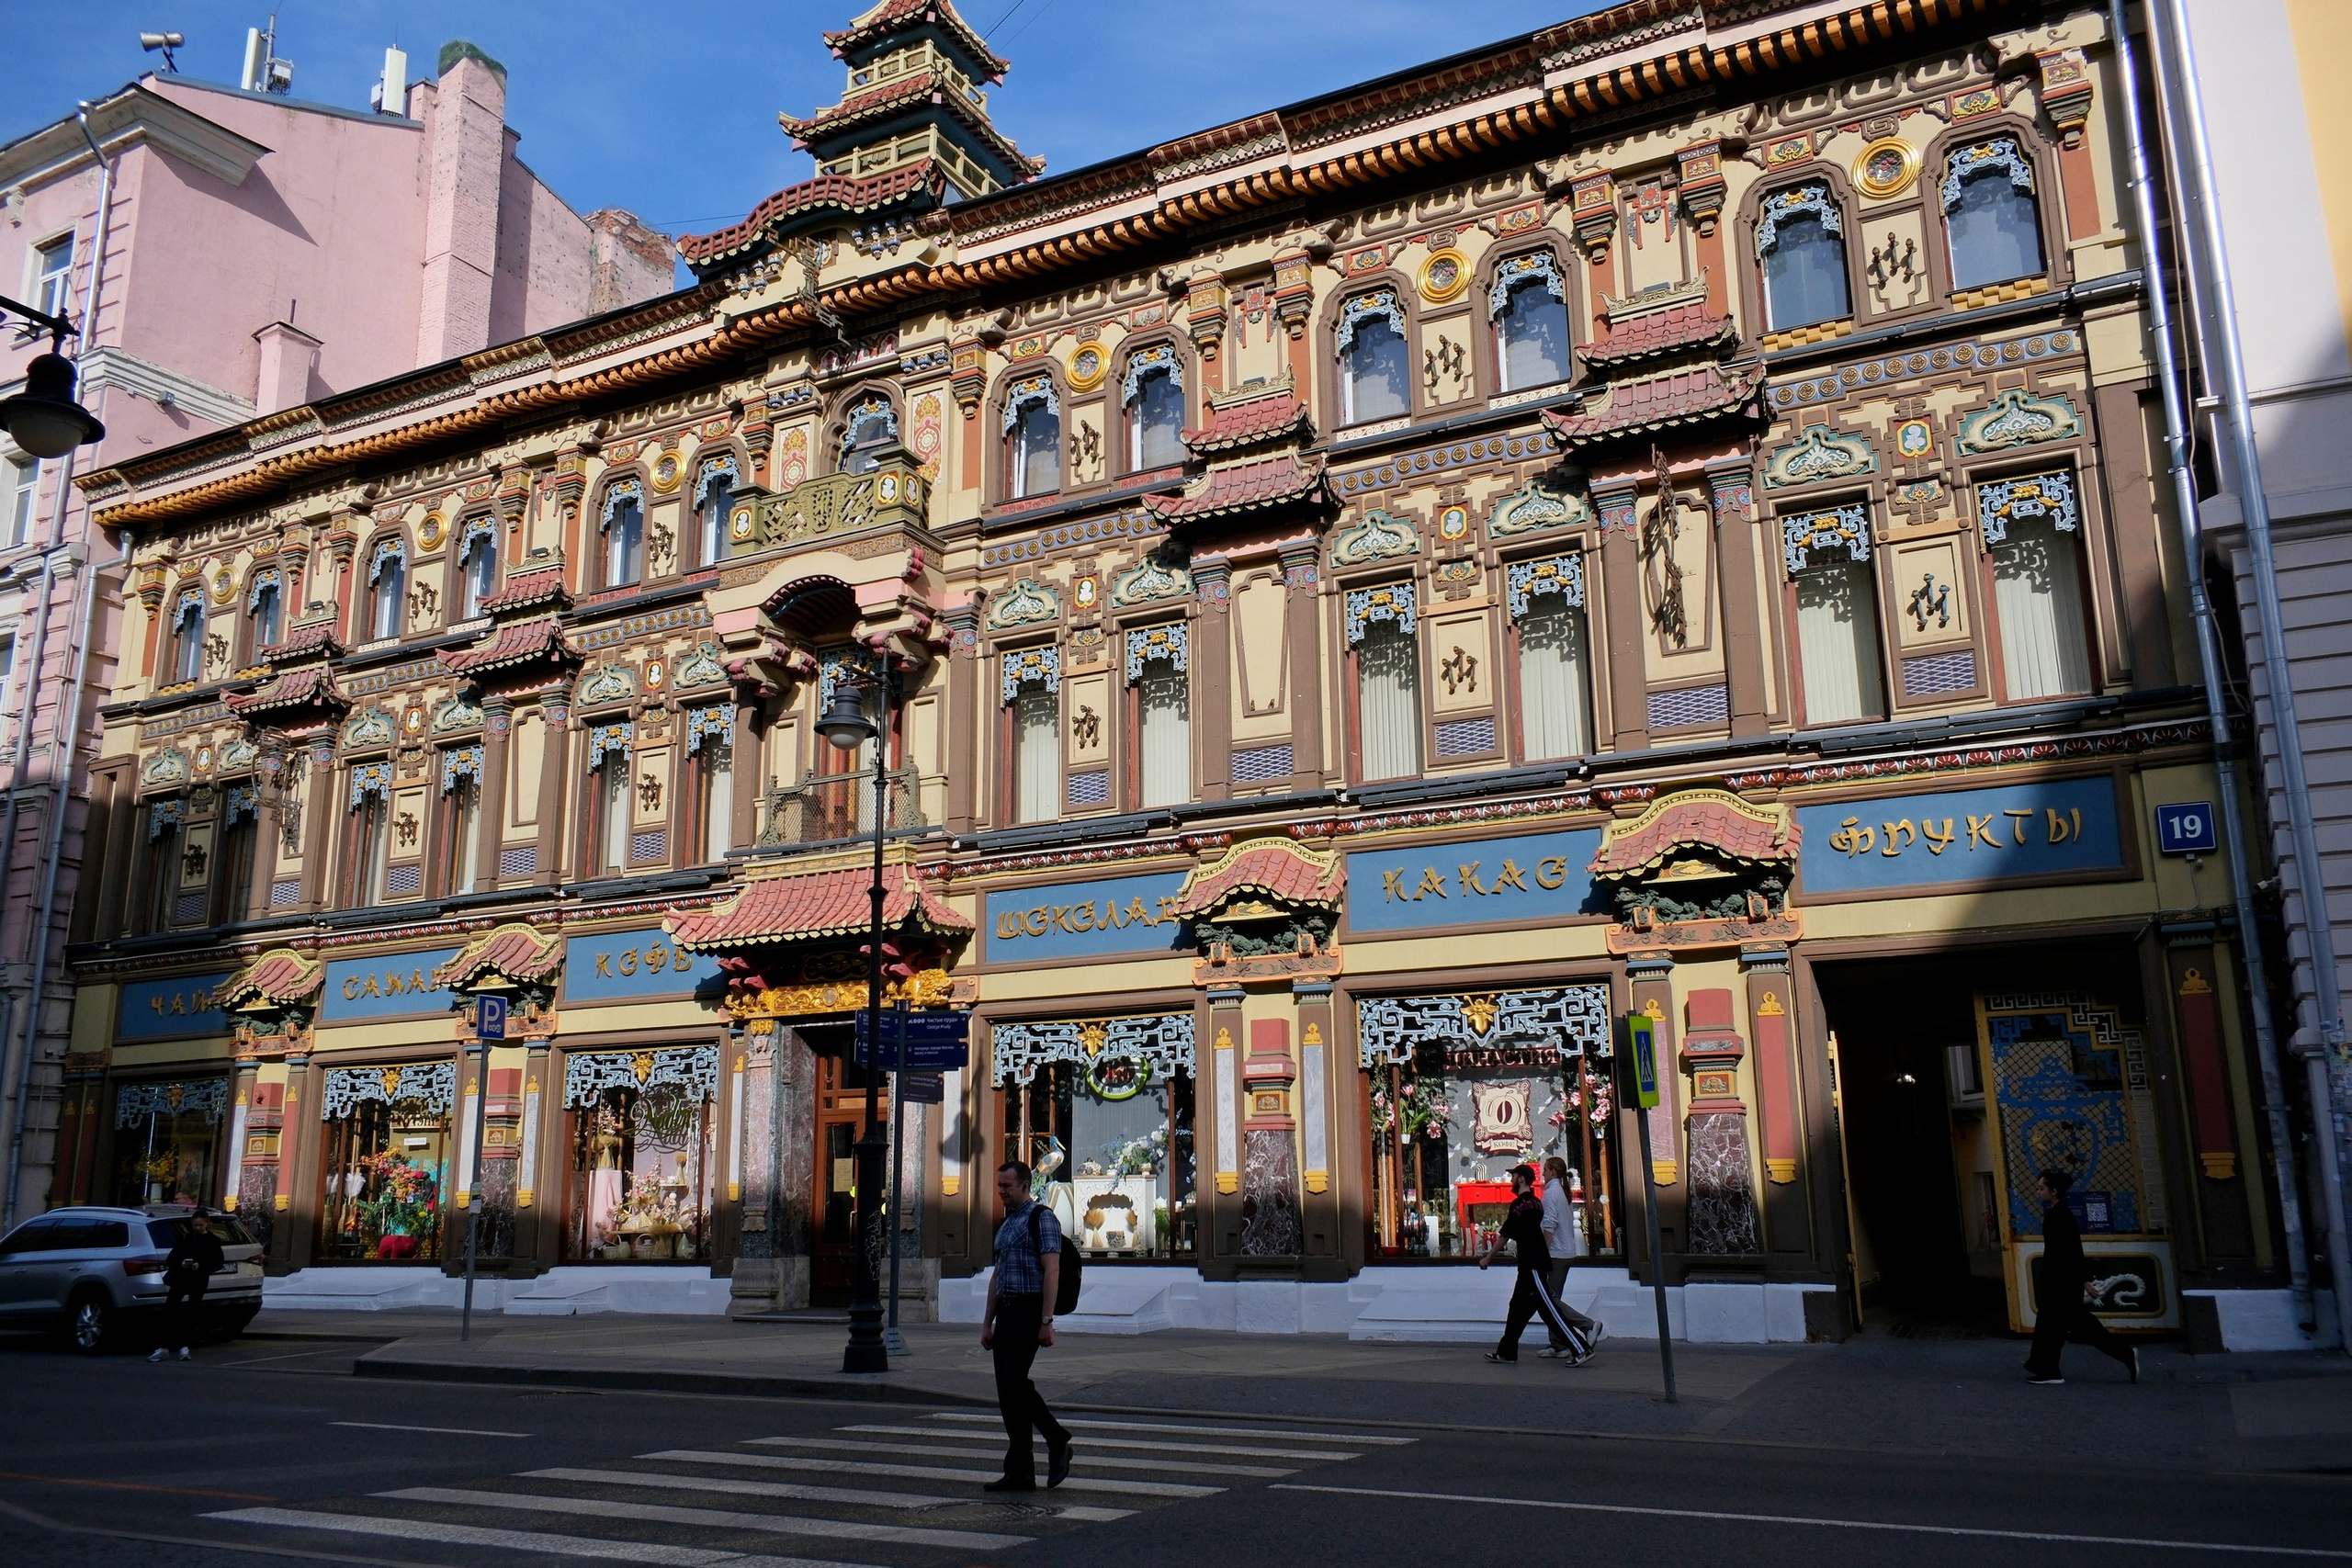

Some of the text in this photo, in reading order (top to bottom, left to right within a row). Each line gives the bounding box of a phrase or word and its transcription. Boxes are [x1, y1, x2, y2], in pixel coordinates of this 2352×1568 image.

[1828, 807, 2082, 858] ФРУКТЫ
[2167, 814, 2203, 840] 19
[1382, 855, 1568, 903] КАКАО
[997, 896, 1182, 939] ШОКОЛАД
[595, 940, 694, 979] КОФЕ
[151, 988, 209, 1017] ЧАЙ
[1445, 1048, 1558, 1070] ДИНАСТИЯ
[1492, 1140, 1516, 1148] КОФЕ
